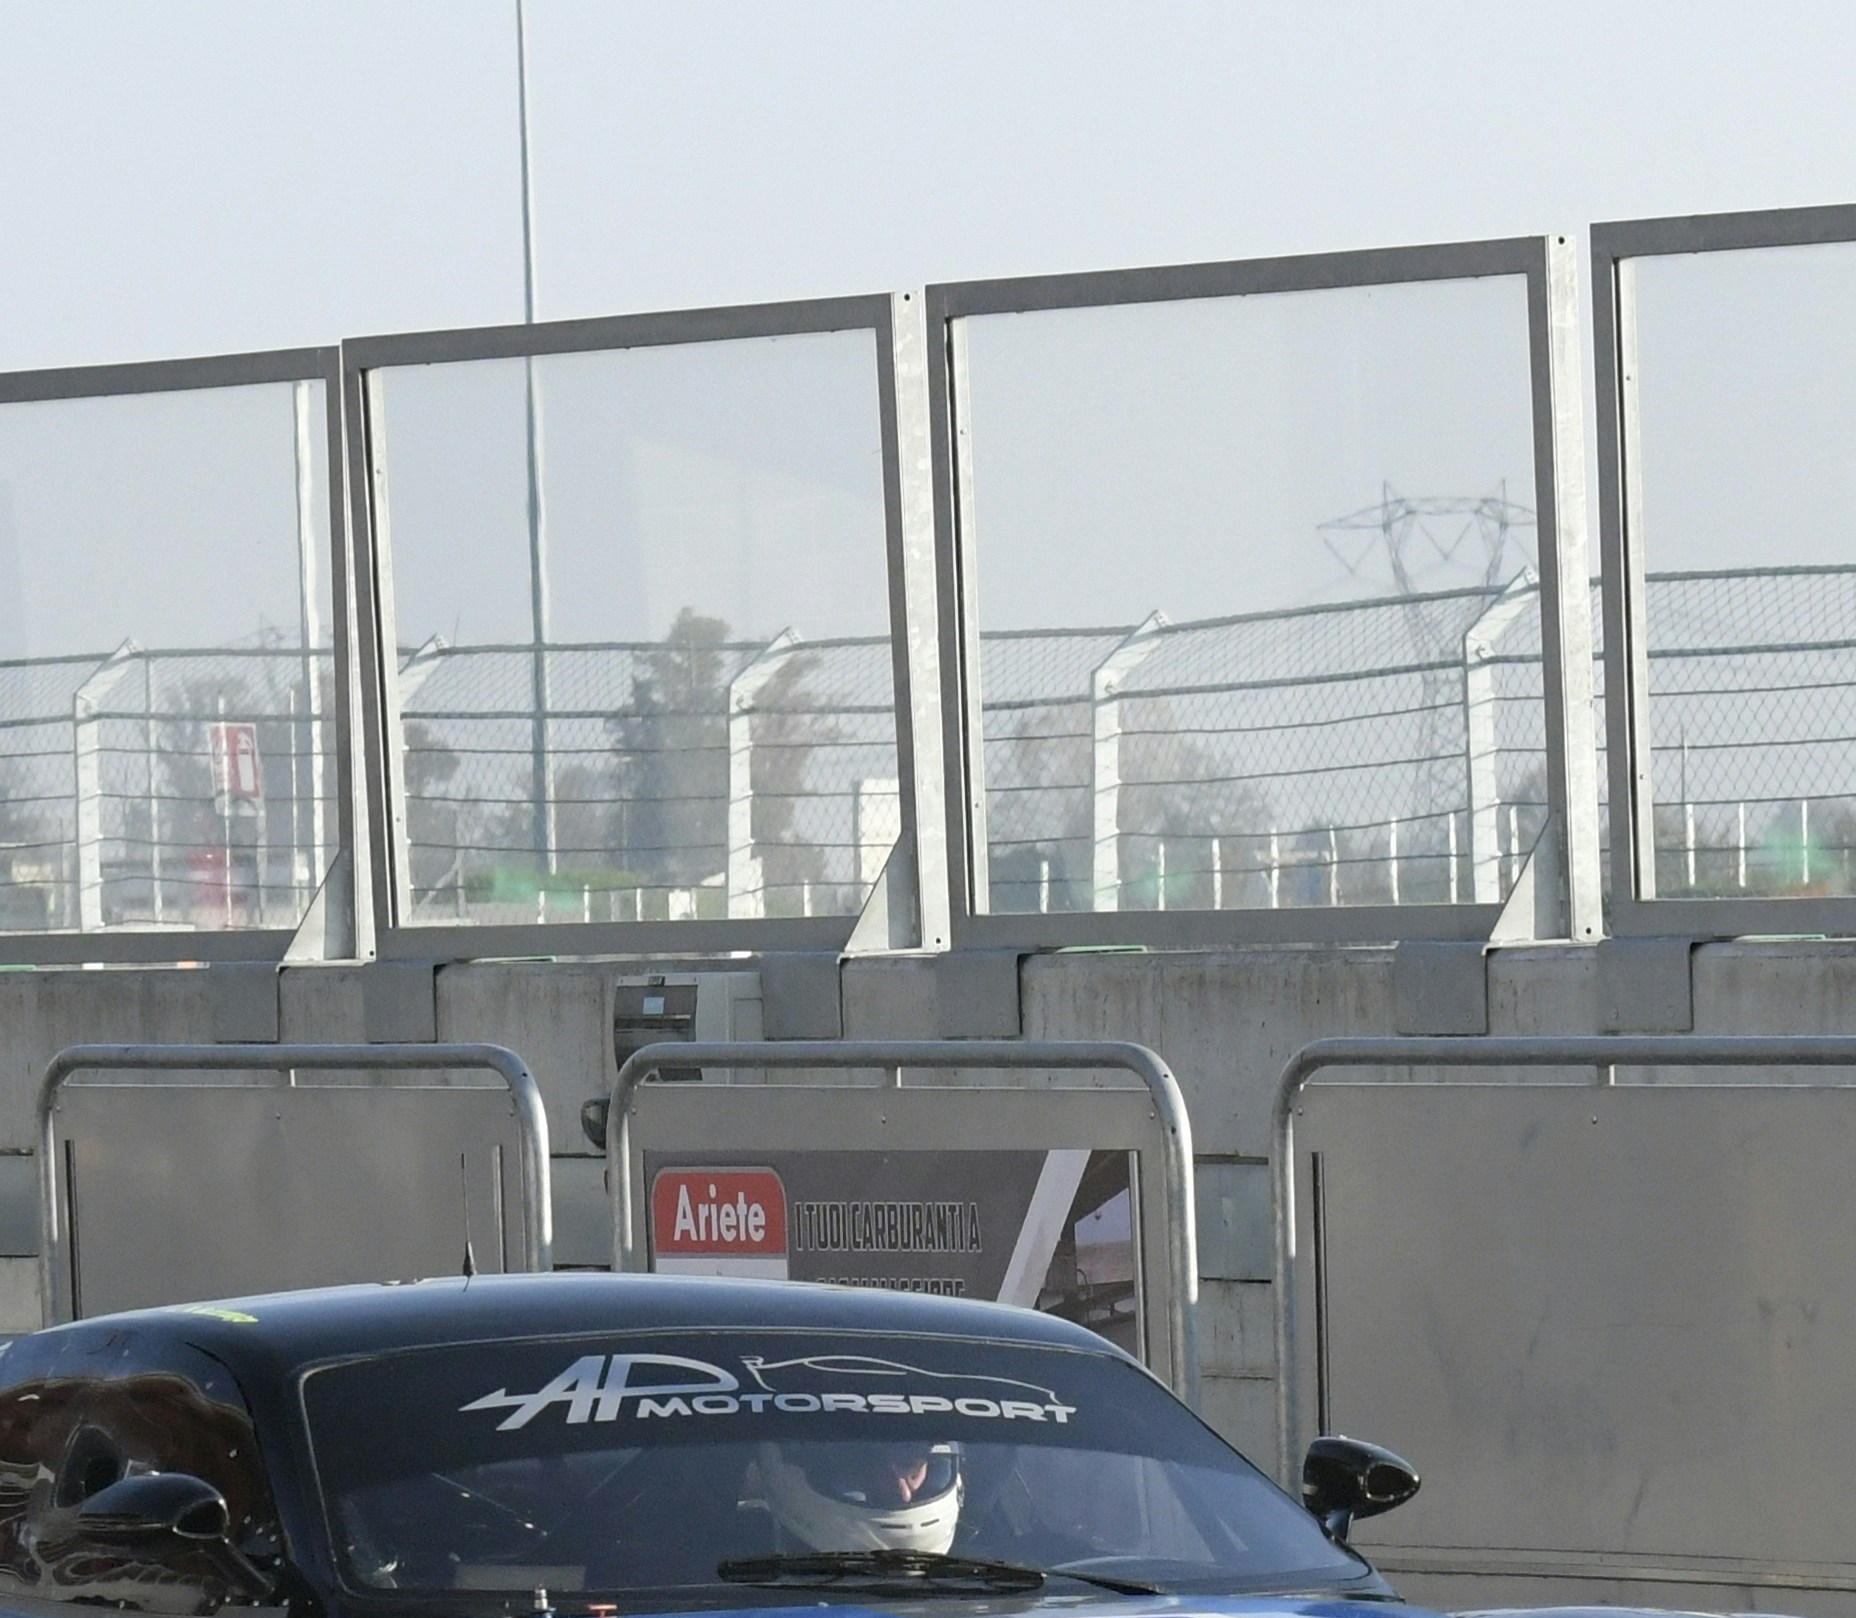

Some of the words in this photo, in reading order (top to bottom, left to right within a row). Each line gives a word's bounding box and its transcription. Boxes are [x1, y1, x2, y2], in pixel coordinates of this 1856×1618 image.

[673, 1184, 766, 1242] Ariete
[804, 1202, 848, 1251] TUOI
[850, 1202, 966, 1252] CARBURANTI
[635, 1392, 1077, 1425] MOTORSPORT
